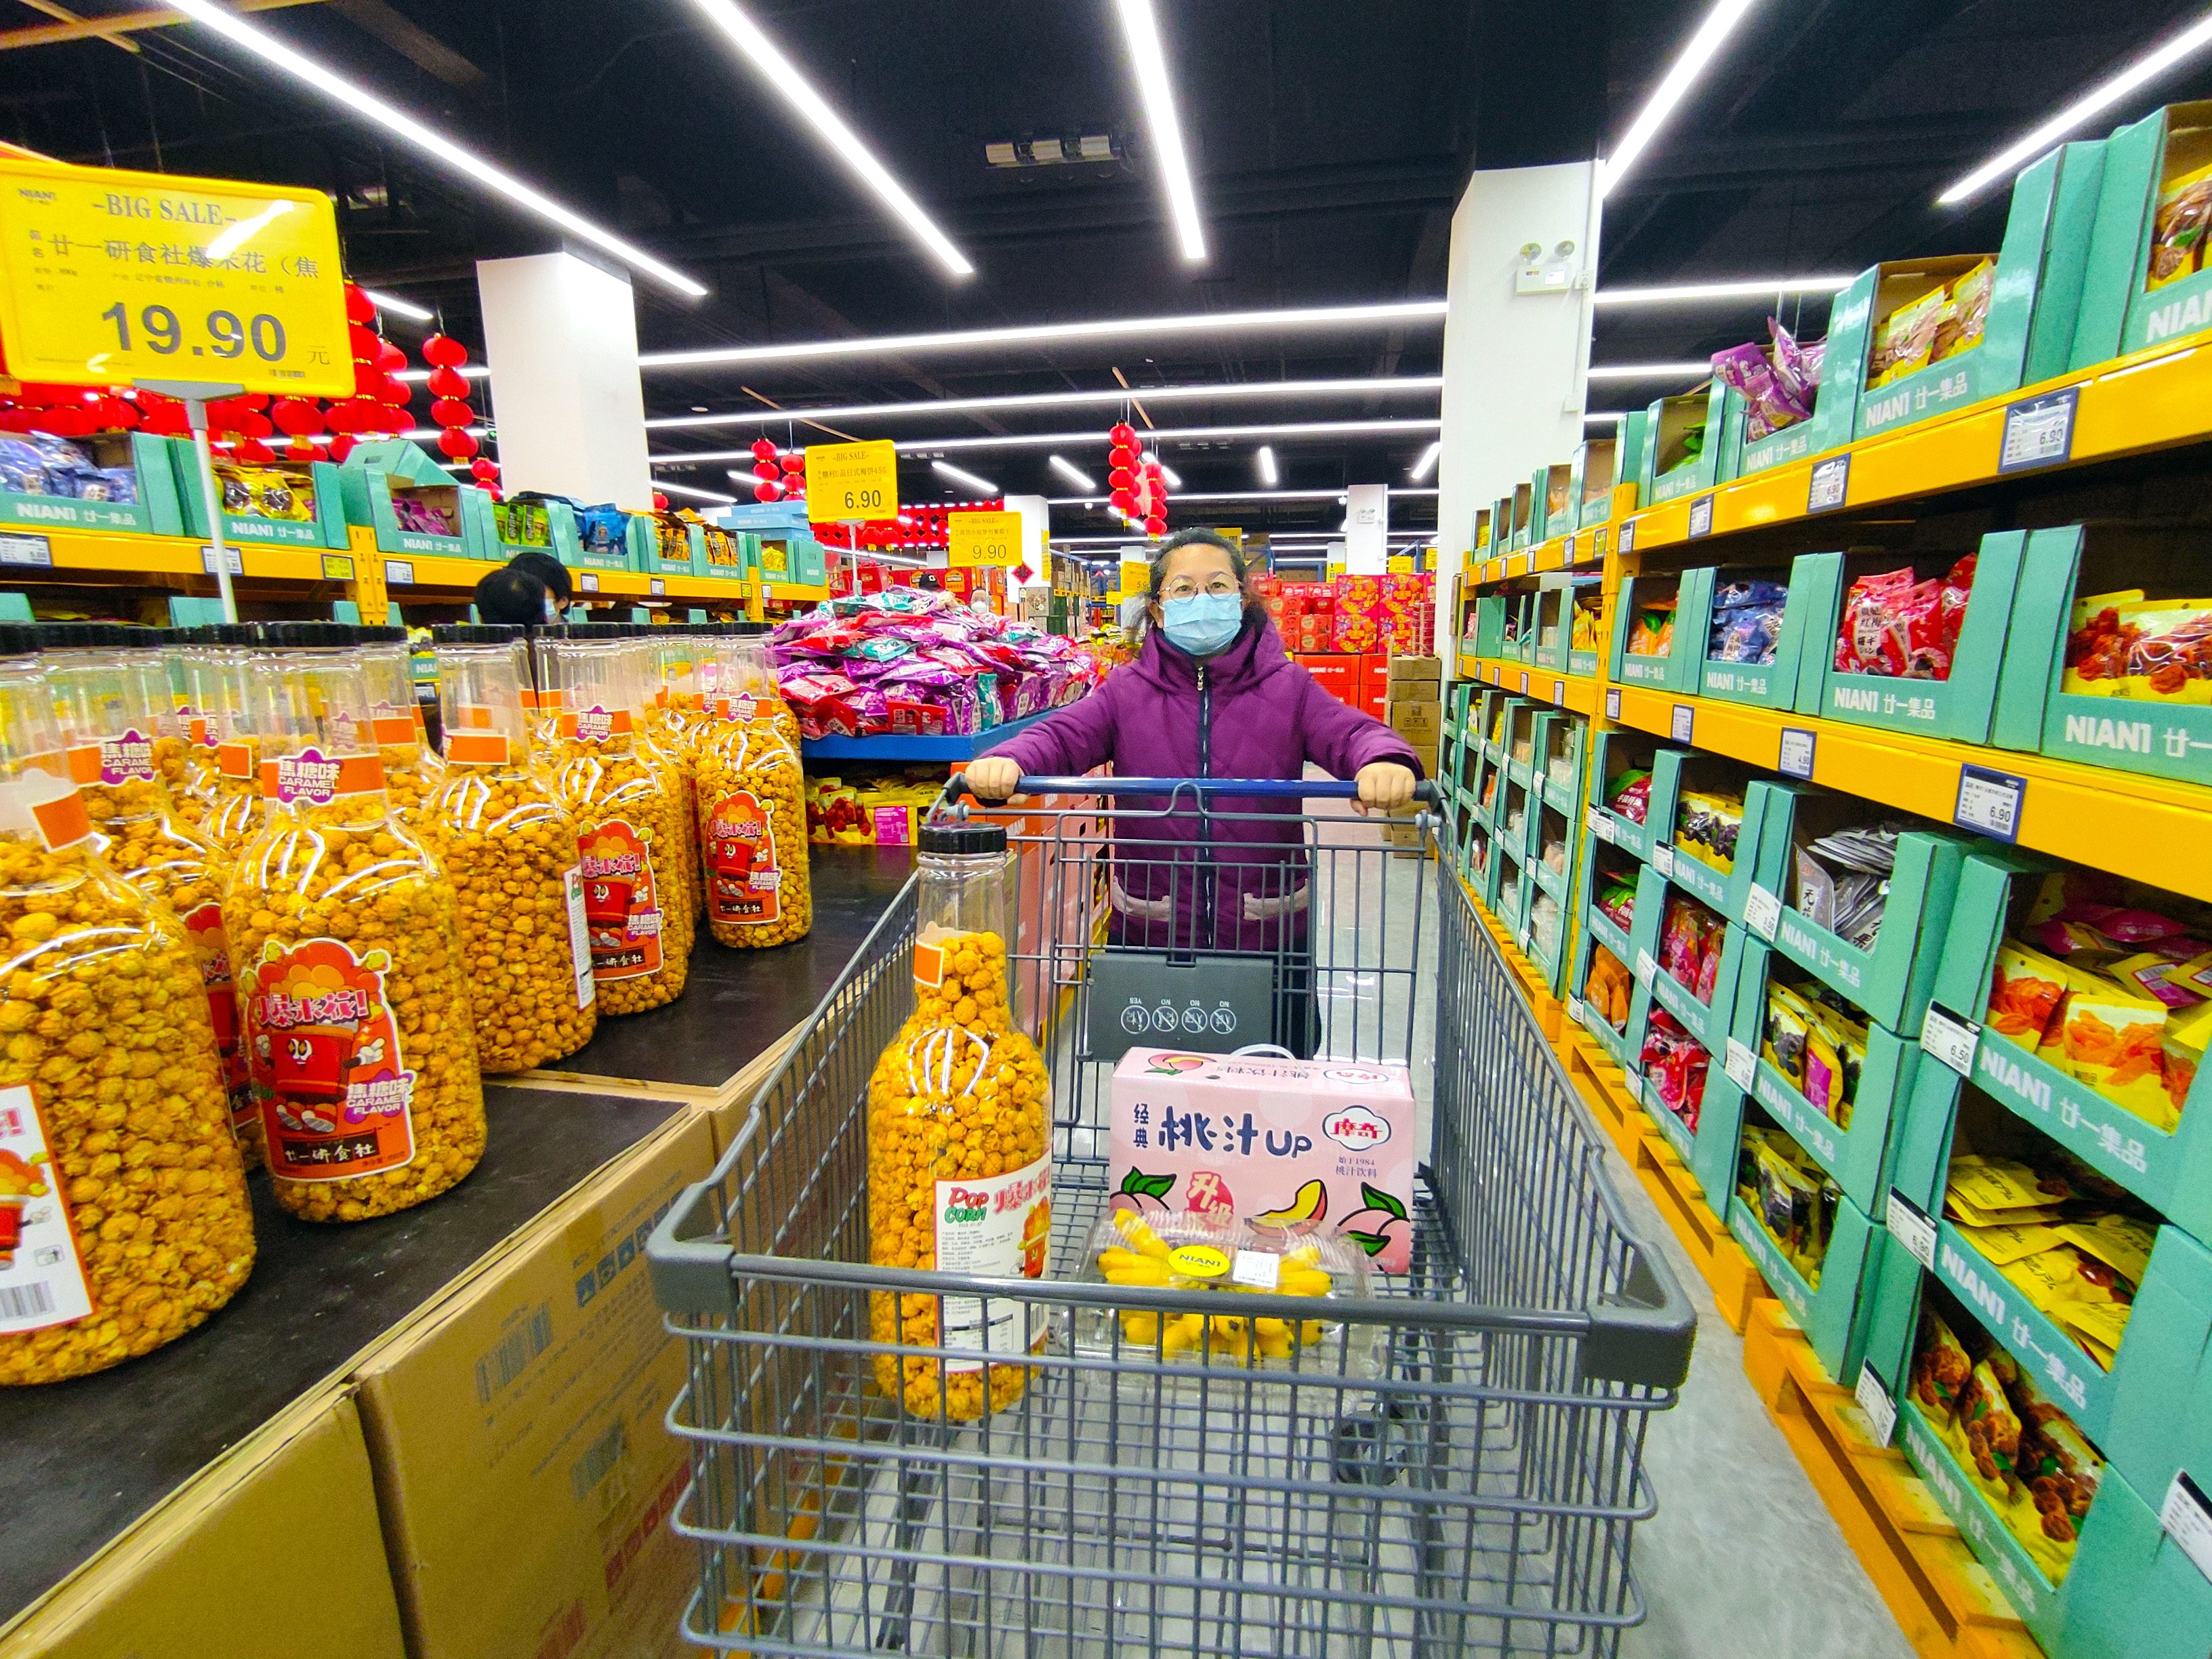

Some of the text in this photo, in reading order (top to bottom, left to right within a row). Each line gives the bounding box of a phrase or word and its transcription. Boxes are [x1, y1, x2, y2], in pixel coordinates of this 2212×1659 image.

[102, 302, 287, 362] 19.90
[307, 345, 331, 365] 元
[844, 489, 881, 509] 6.90
[972, 544, 1006, 559] 9.90
[1883, 693, 1936, 720] 廿一集品
[279, 760, 340, 779] 焦糖味
[279, 777, 340, 790] CARAMEL
[284, 787, 331, 798] FLAVOR
[1990, 806, 2011, 822] 6.90
[255, 989, 369, 1027] 爆米花!
[353, 1102, 401, 1115] FLAVOR
[1133, 1103, 1149, 1149] 经典
[1330, 1118, 1383, 1139] 摩奇
[2059, 1097, 2148, 1174] 廿一集品
[285, 1142, 377, 1164] 廿一研食社
[1338, 1155, 1375, 1166] 始于1984
[1336, 1165, 1377, 1179] 桃汁饮料
[1189, 1173, 1233, 1229] 升级
[2010, 1316, 2087, 1410] 廿一集品
